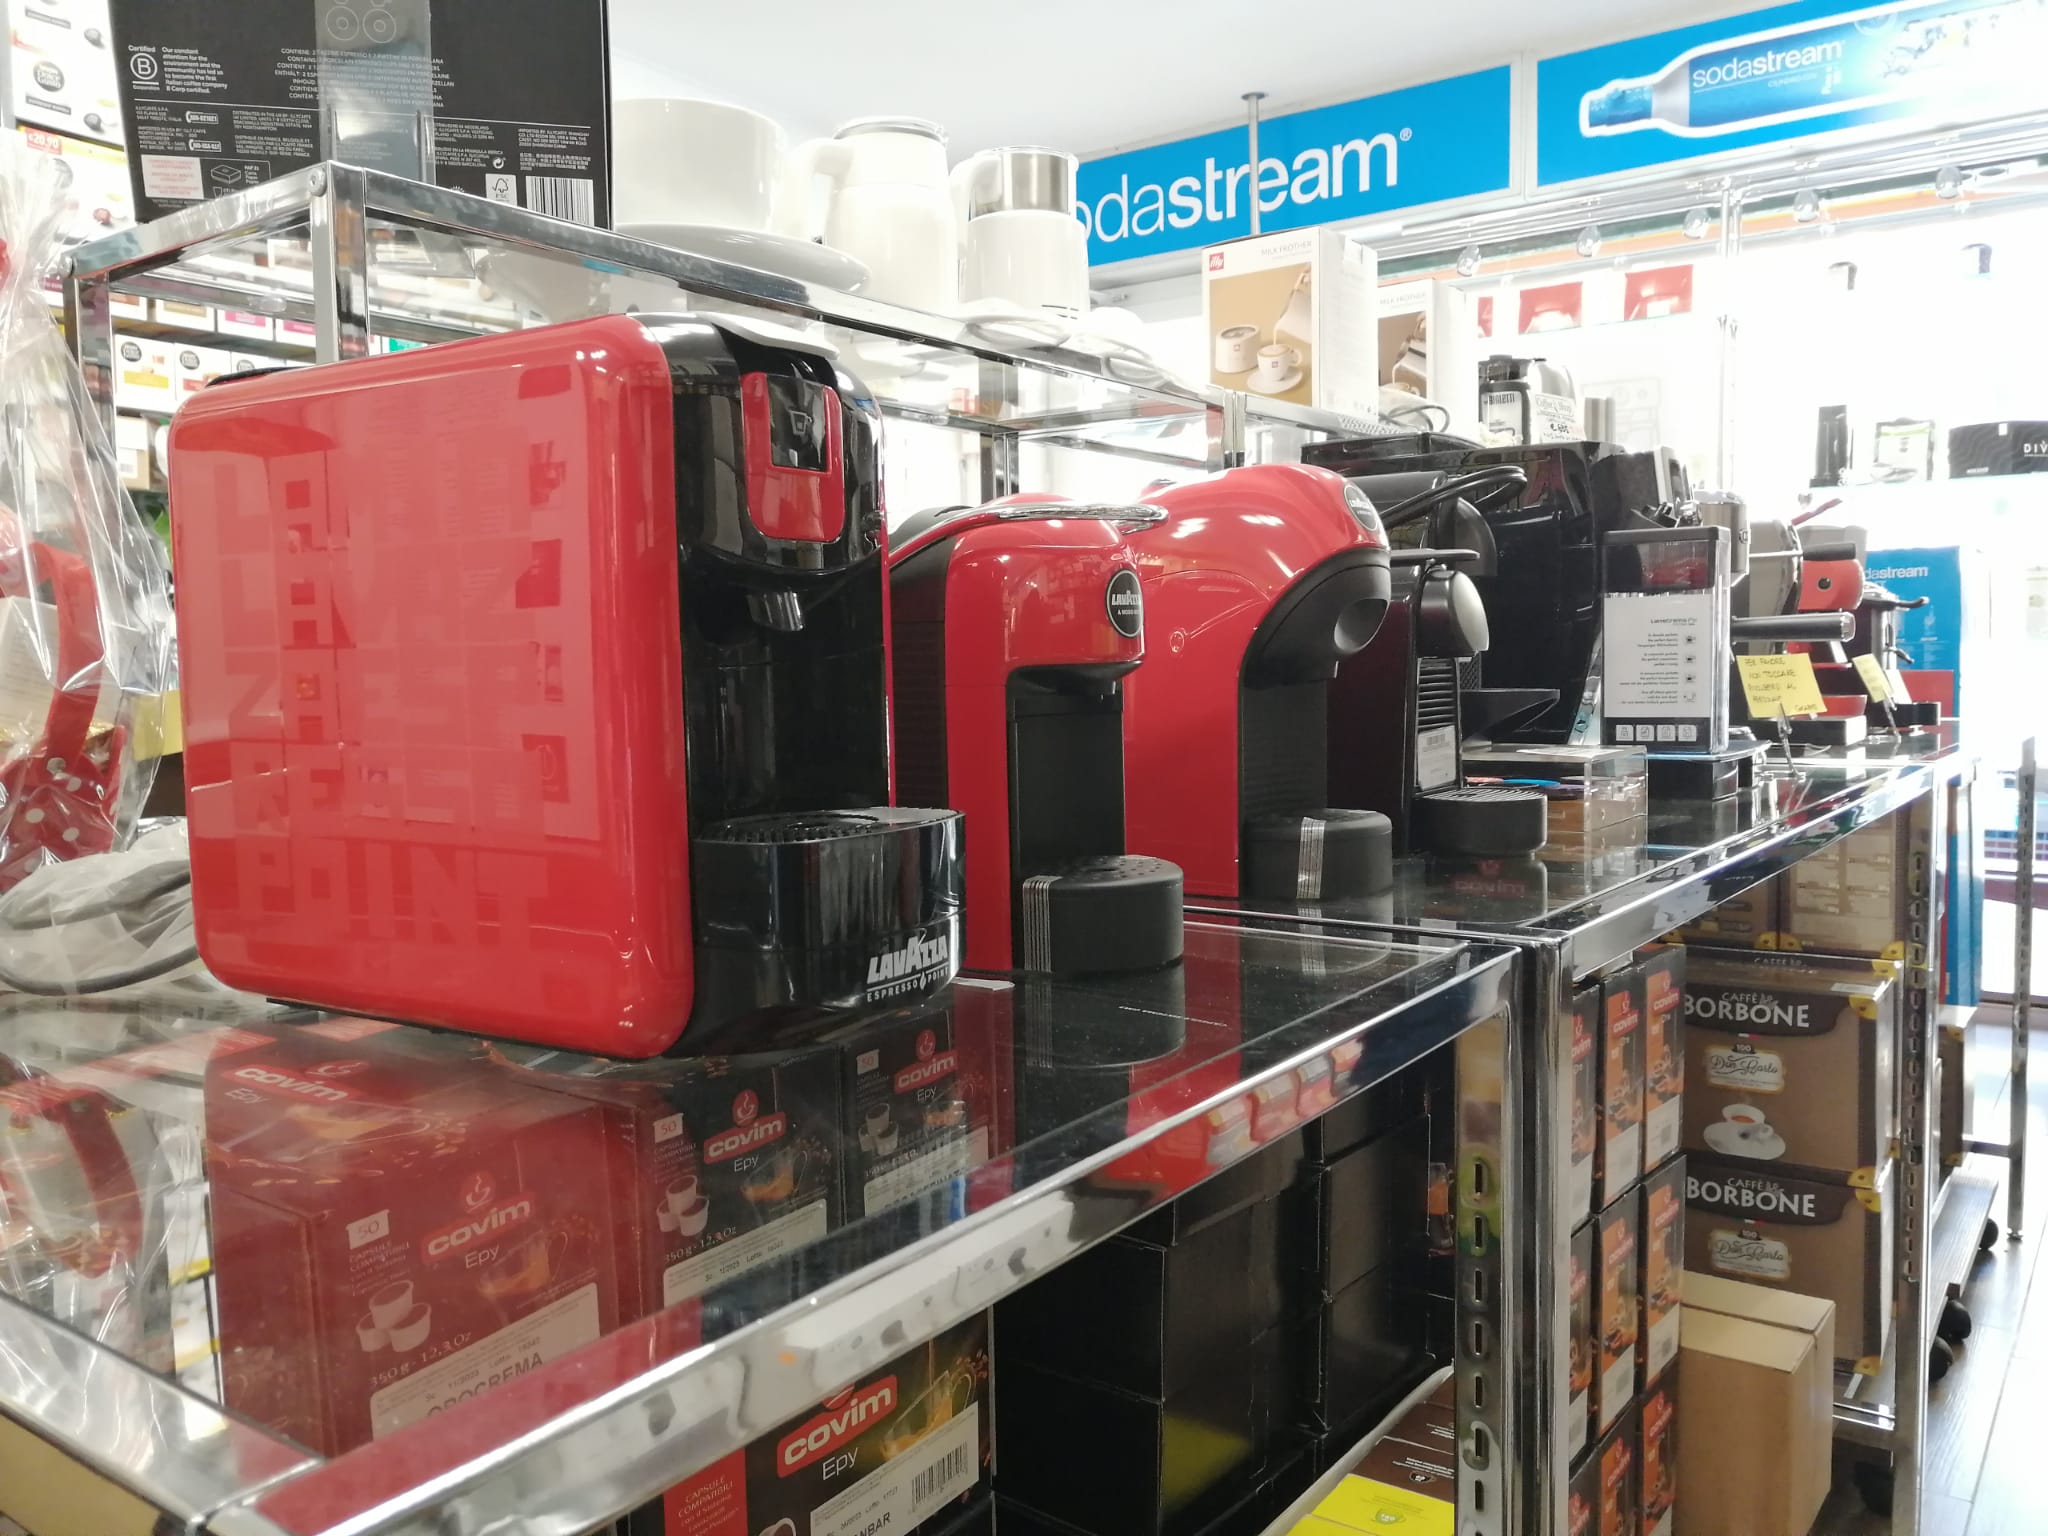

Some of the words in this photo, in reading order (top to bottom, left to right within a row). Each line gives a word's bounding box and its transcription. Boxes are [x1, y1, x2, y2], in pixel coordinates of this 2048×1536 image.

[128, 44, 156, 53] Certified
[1692, 40, 1843, 89] sodastream
[201, 81, 228, 90] company
[1864, 566, 1929, 580] dastream
[866, 933, 948, 985] LAVAZZA
[867, 979, 918, 1003] ESPRESSO
[927, 966, 949, 984] POINT
[1721, 991, 1759, 1004] CAFFÈ
[1684, 994, 1810, 1029] BORBONE
[1736, 1043, 1752, 1052] 100
[234, 1068, 349, 1102] covim
[898, 1055, 955, 1089] covim
[917, 1086, 937, 1103] Epy
[661, 1120, 677, 1135] 50
[708, 1119, 782, 1158] covim
[733, 1154, 760, 1173] Epy
[1686, 1175, 1816, 1218] BORBONE
[358, 1220, 380, 1240] 50
[427, 1200, 531, 1257] covim
[464, 1244, 501, 1270] Epy
[783, 1386, 892, 1466] covim
[822, 1447, 859, 1481] Epy
[678, 1480, 734, 1518] COMPATIBILI
[685, 1474, 726, 1503] CAPSULE
